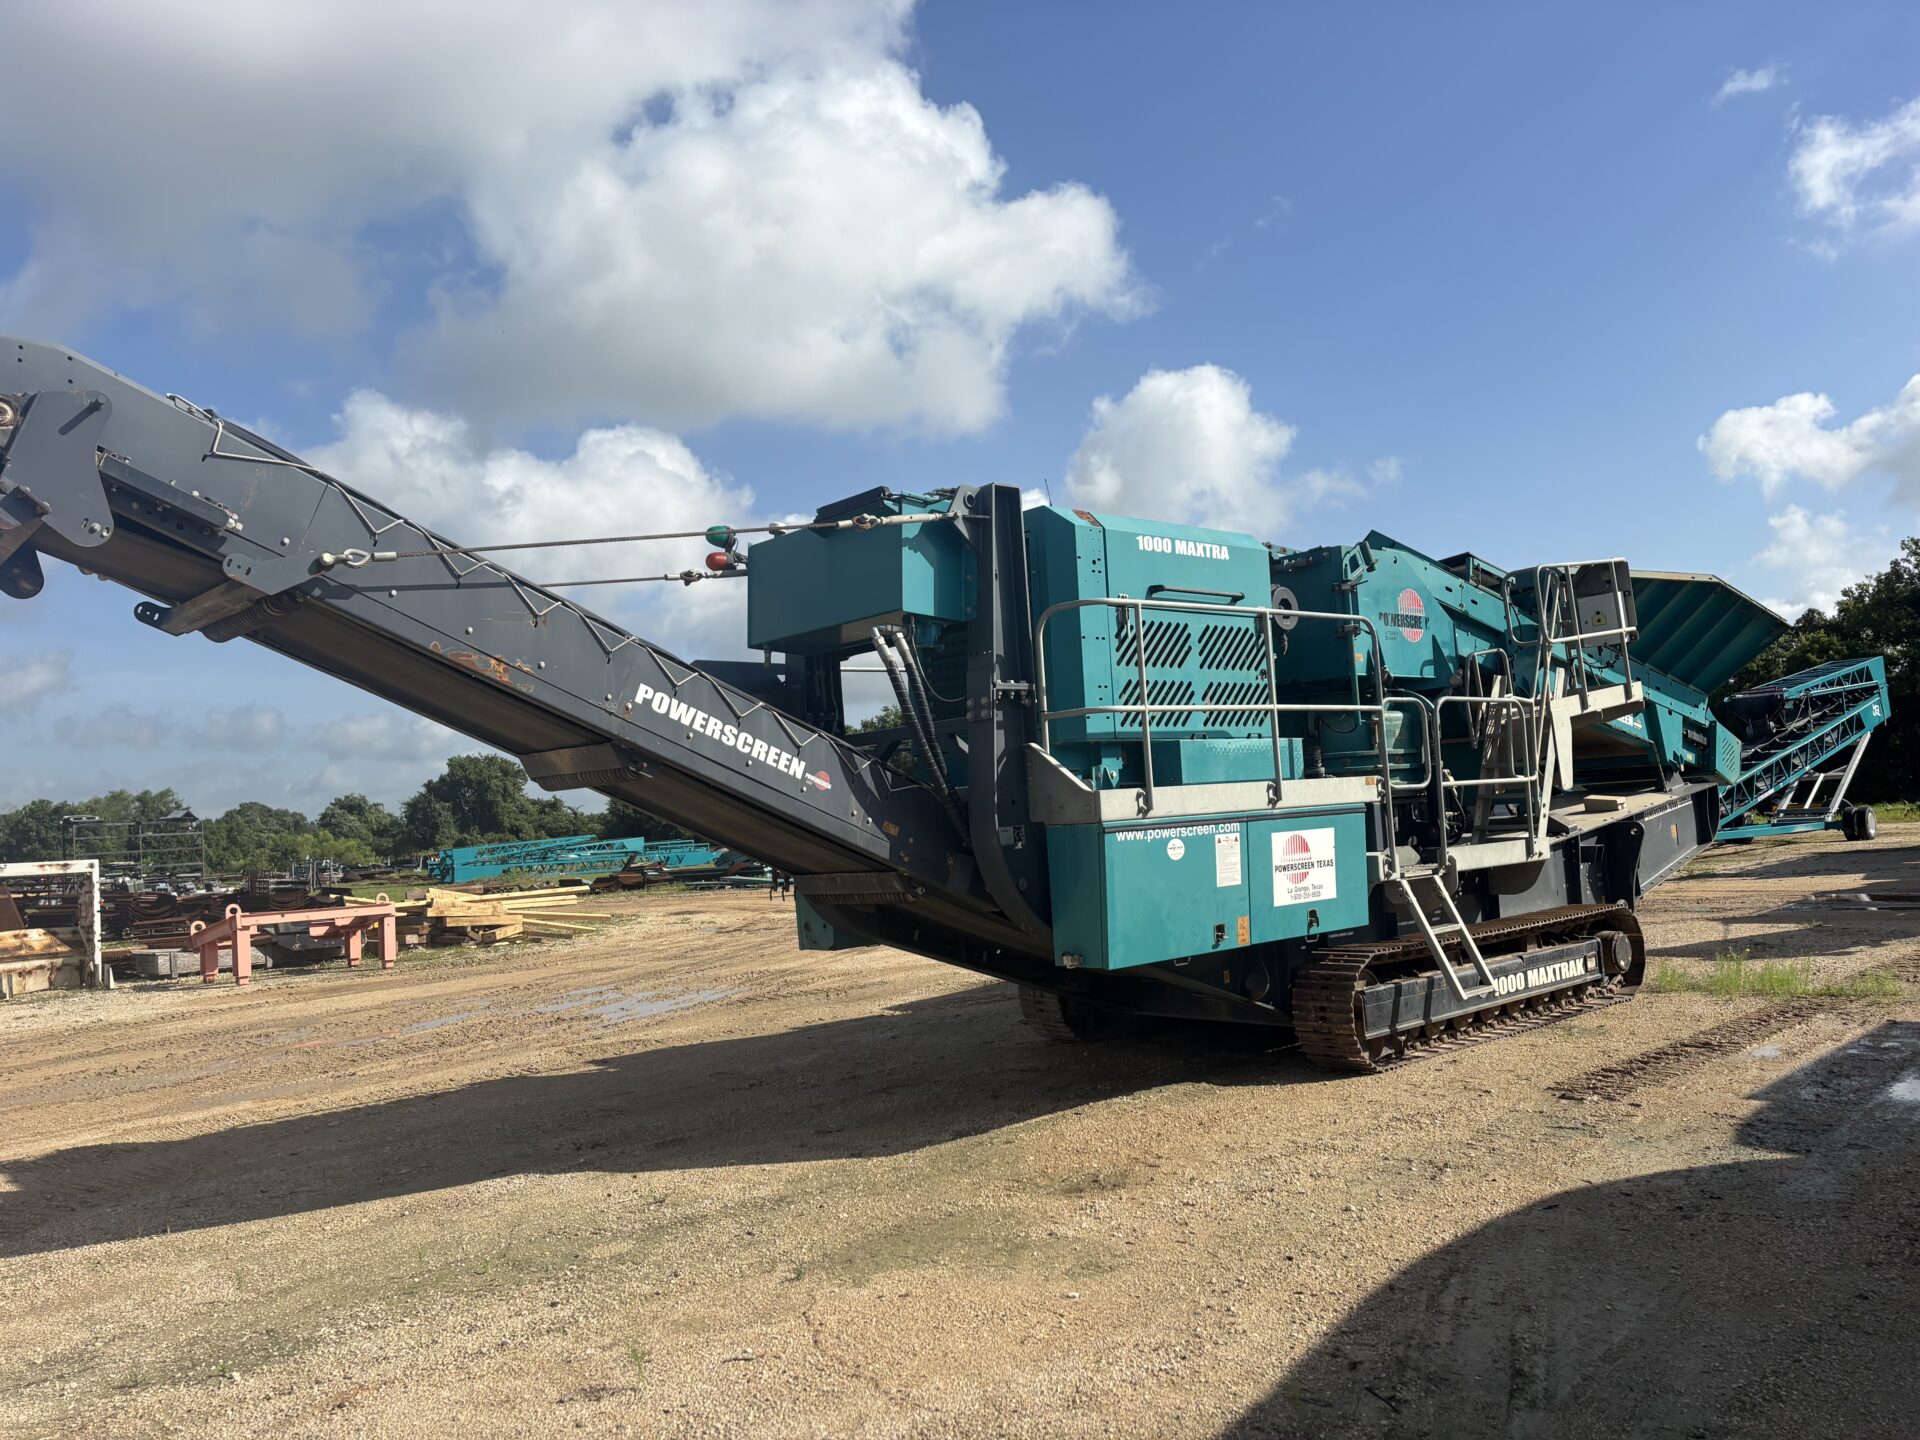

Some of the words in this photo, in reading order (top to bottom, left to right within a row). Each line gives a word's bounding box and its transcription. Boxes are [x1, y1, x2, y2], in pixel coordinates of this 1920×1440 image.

[1136, 535, 1172, 553] 1000
[1174, 539, 1230, 560] MAXTRA
[634, 683, 806, 780] POWERSCREEN
[1115, 822, 1240, 843] www.powerscreen.com
[1274, 861, 1315, 873] POWERSCREEN
[1316, 859, 1334, 868] TEXAS
[1527, 957, 1585, 988] MAXTRAK
